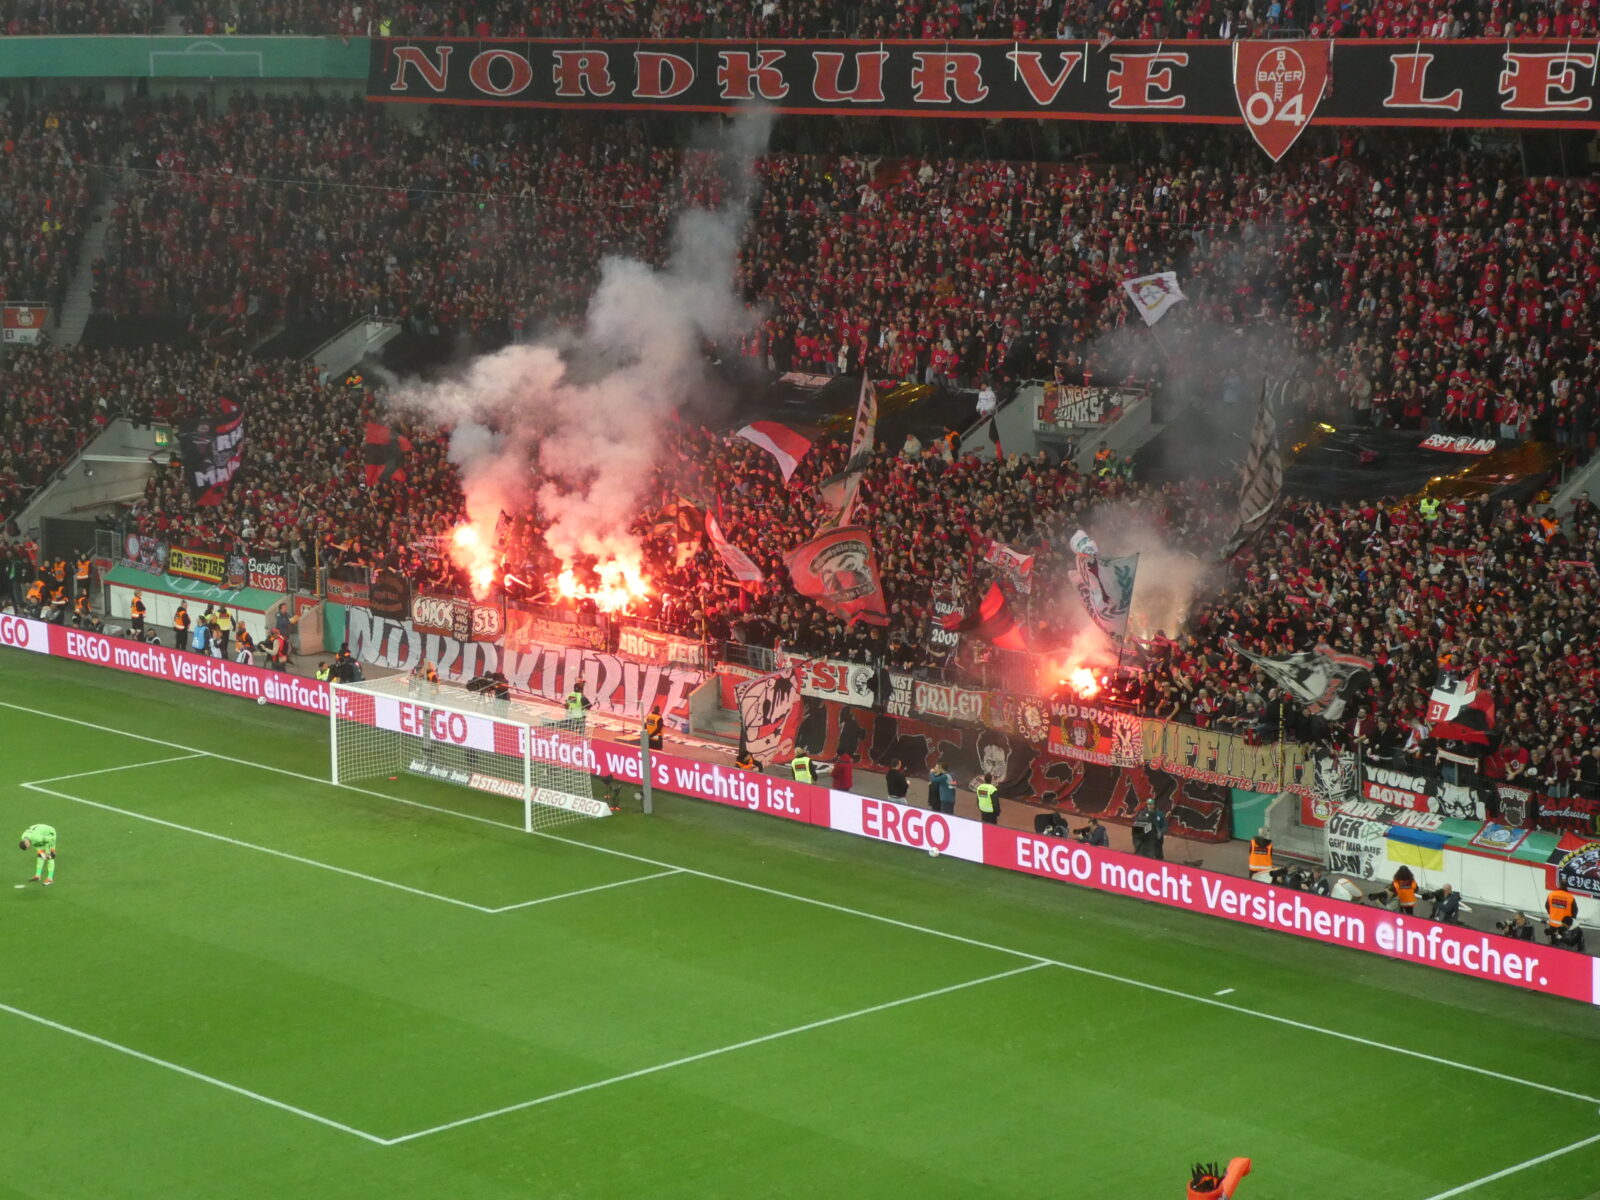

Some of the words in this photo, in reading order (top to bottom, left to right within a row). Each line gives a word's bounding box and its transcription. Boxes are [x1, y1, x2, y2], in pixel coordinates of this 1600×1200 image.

[391, 46, 1189, 109] NORDKURVE
[1258, 70, 1303, 83] BAYER
[1275, 50, 1285, 103] BAYER
[1246, 92, 1306, 126] 04
[249, 557, 284, 577] Bayer
[0, 616, 29, 648] GO
[473, 607, 500, 635] 513
[931, 628, 959, 647] 2009
[67, 631, 111, 663] ERGO
[115, 646, 167, 676] macht
[170, 653, 260, 696] Versichern
[264, 675, 353, 717] einfacher.
[399, 702, 468, 745] ERGO
[1048, 742, 1112, 765] LEVERKUSEN
[518, 727, 602, 776] Einfach,
[606, 751, 670, 785] wei's
[674, 762, 760, 810] wichtig
[766, 780, 801, 815] ist.
[1365, 765, 1426, 794] YOUNG
[537, 791, 568, 807] ERGO
[571, 797, 602, 815] ERGO
[1369, 785, 1416, 809] BOYS
[861, 798, 951, 852] ERGO
[1328, 815, 1364, 840] DER
[1016, 837, 1093, 880] ERGO
[1100, 862, 1193, 905] macht
[1200, 876, 1365, 945] Versichern
[1374, 918, 1549, 987] einfacher.
